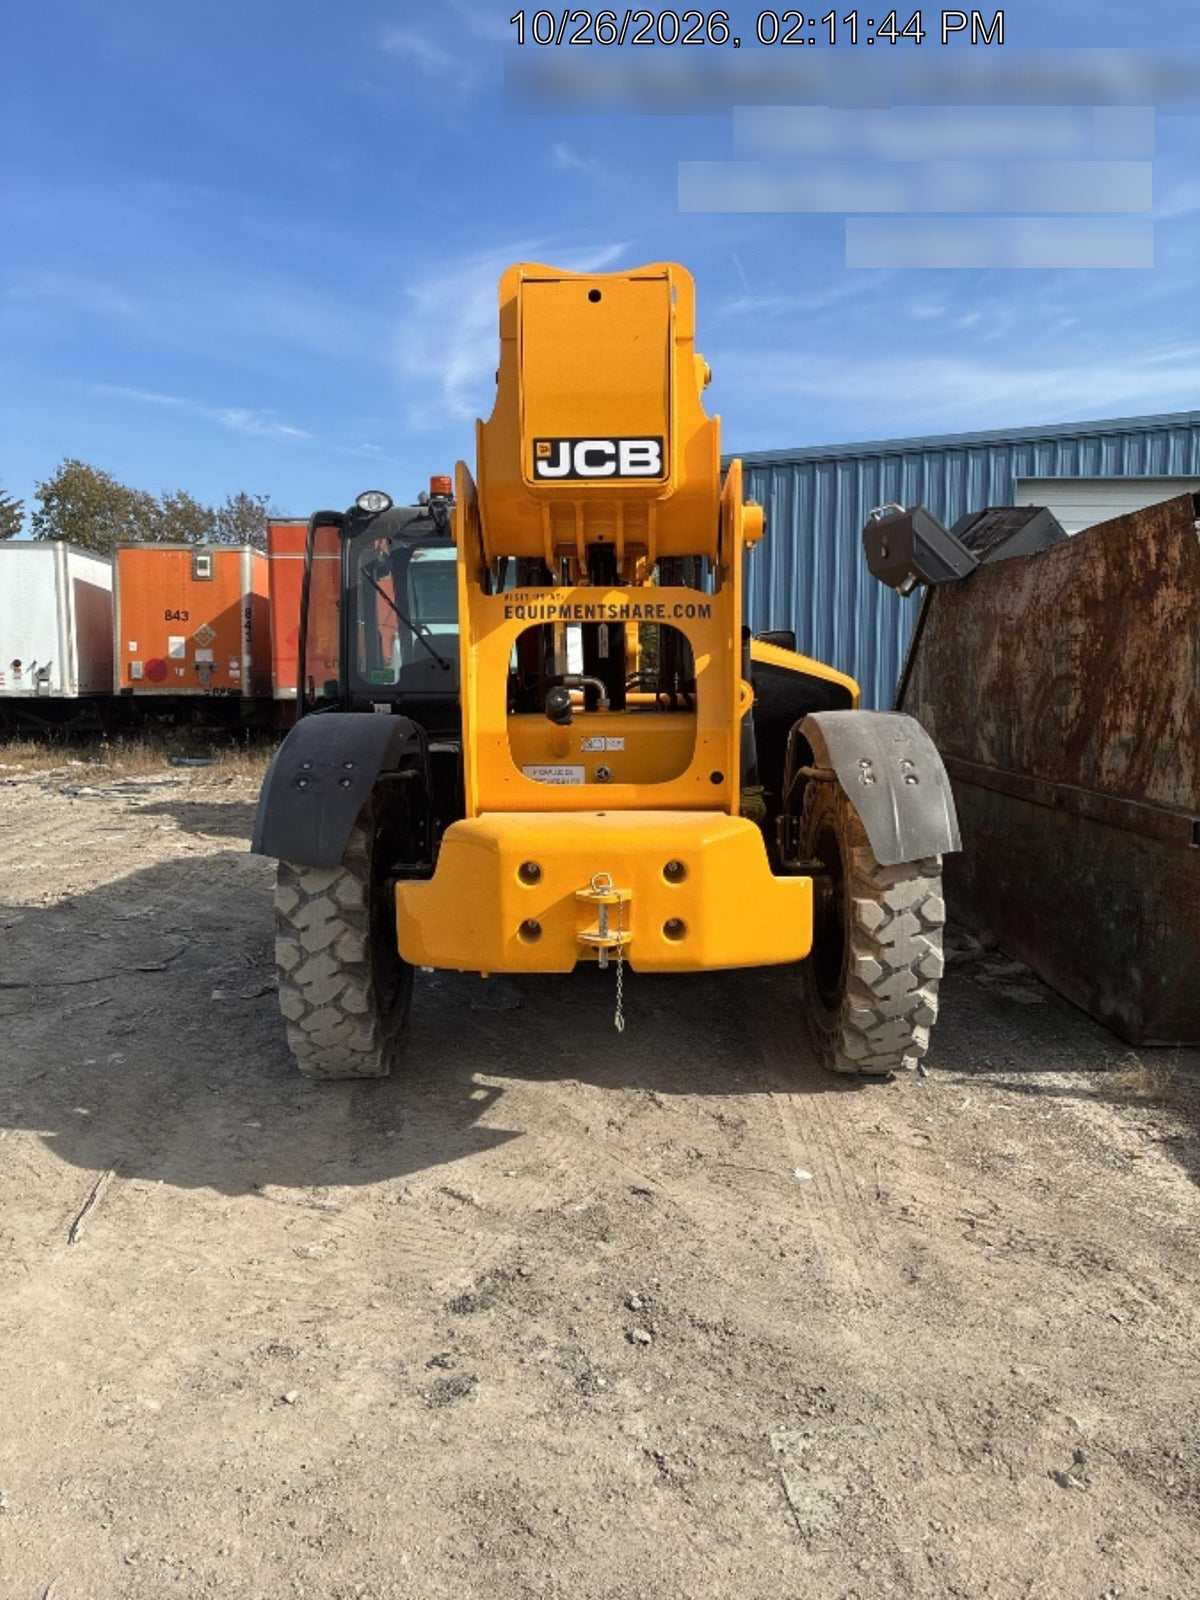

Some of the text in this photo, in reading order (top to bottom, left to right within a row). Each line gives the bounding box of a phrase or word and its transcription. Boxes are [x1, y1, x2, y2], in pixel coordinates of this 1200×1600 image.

[536, 440, 661, 477] JCB
[164, 609, 189, 621] 843
[504, 604, 711, 620] EQUIPMENTSHARE.COM
